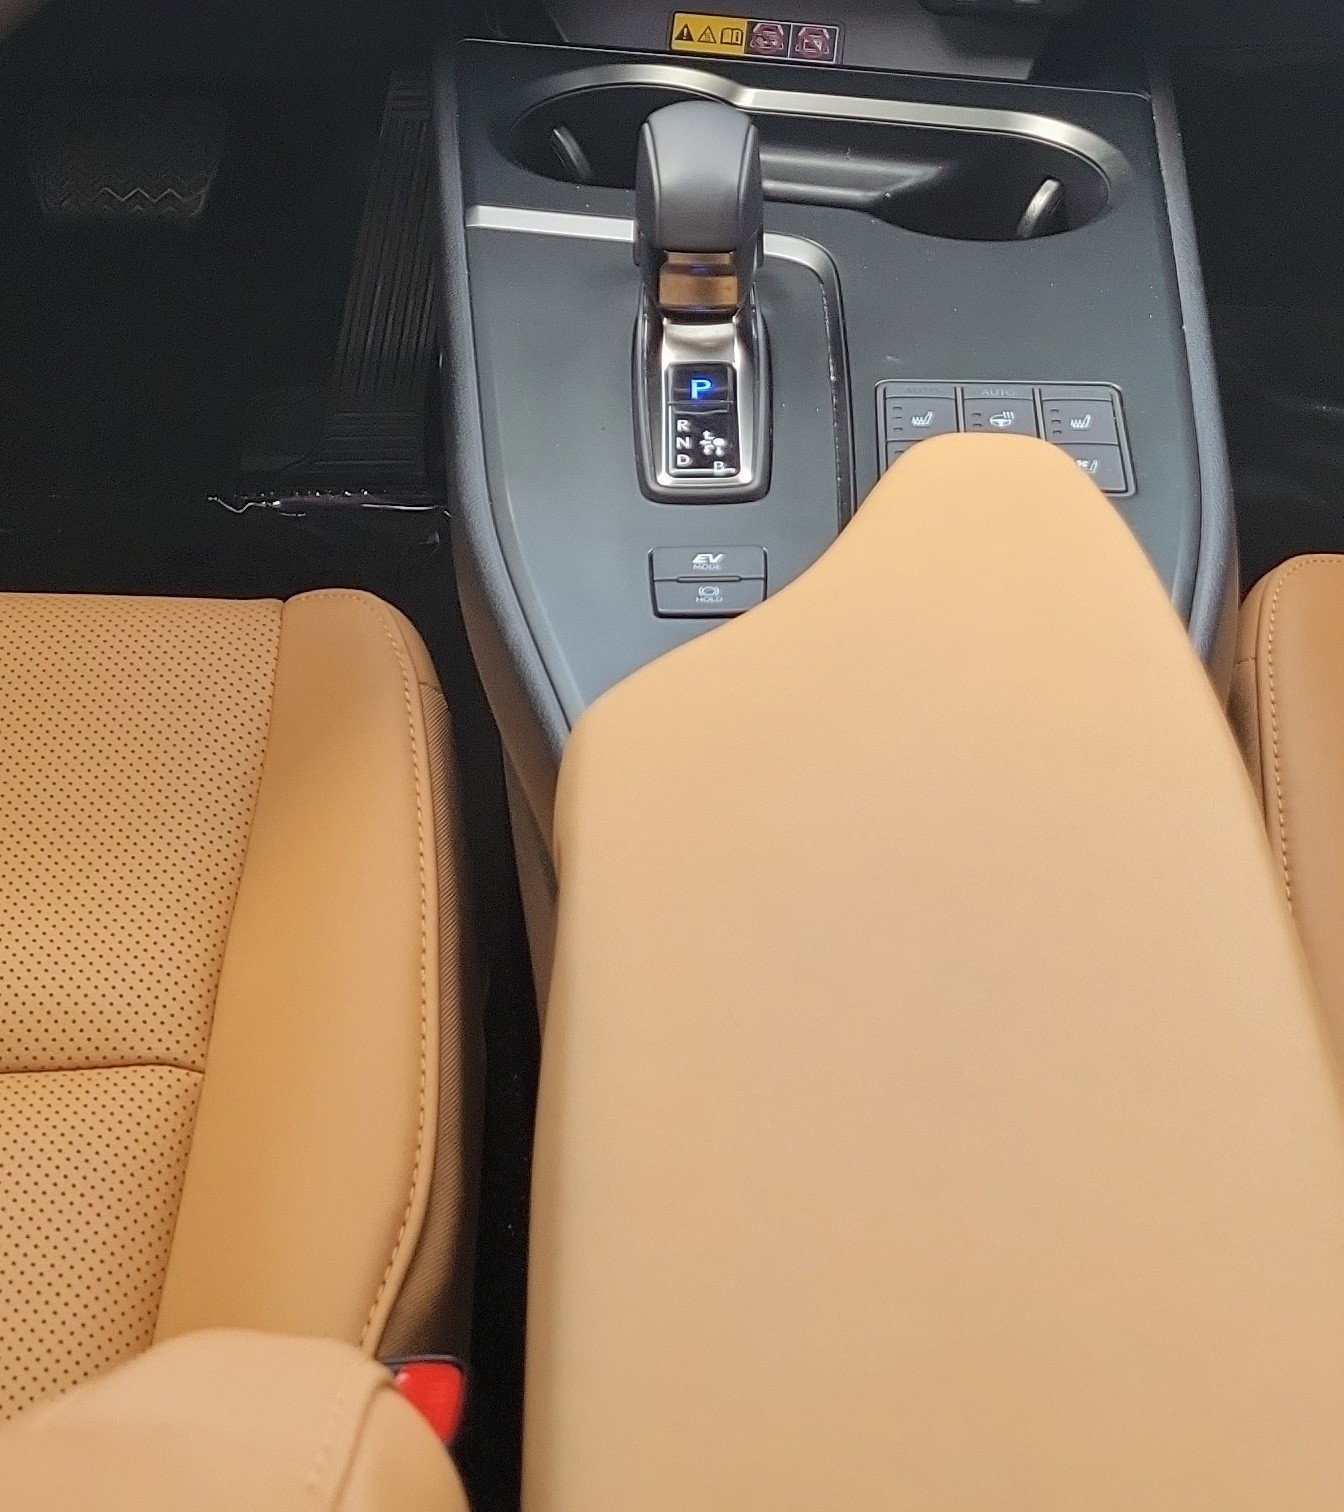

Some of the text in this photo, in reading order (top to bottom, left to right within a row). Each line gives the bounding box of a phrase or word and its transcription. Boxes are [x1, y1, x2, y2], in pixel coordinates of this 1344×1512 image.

[690, 379, 712, 399] P
[676, 419, 690, 432] R
[676, 437, 690, 449] N
[676, 454, 691, 467] D
[713, 461, 724, 476] B
[692, 553, 724, 563] EV
[696, 596, 723, 604] HOLD
